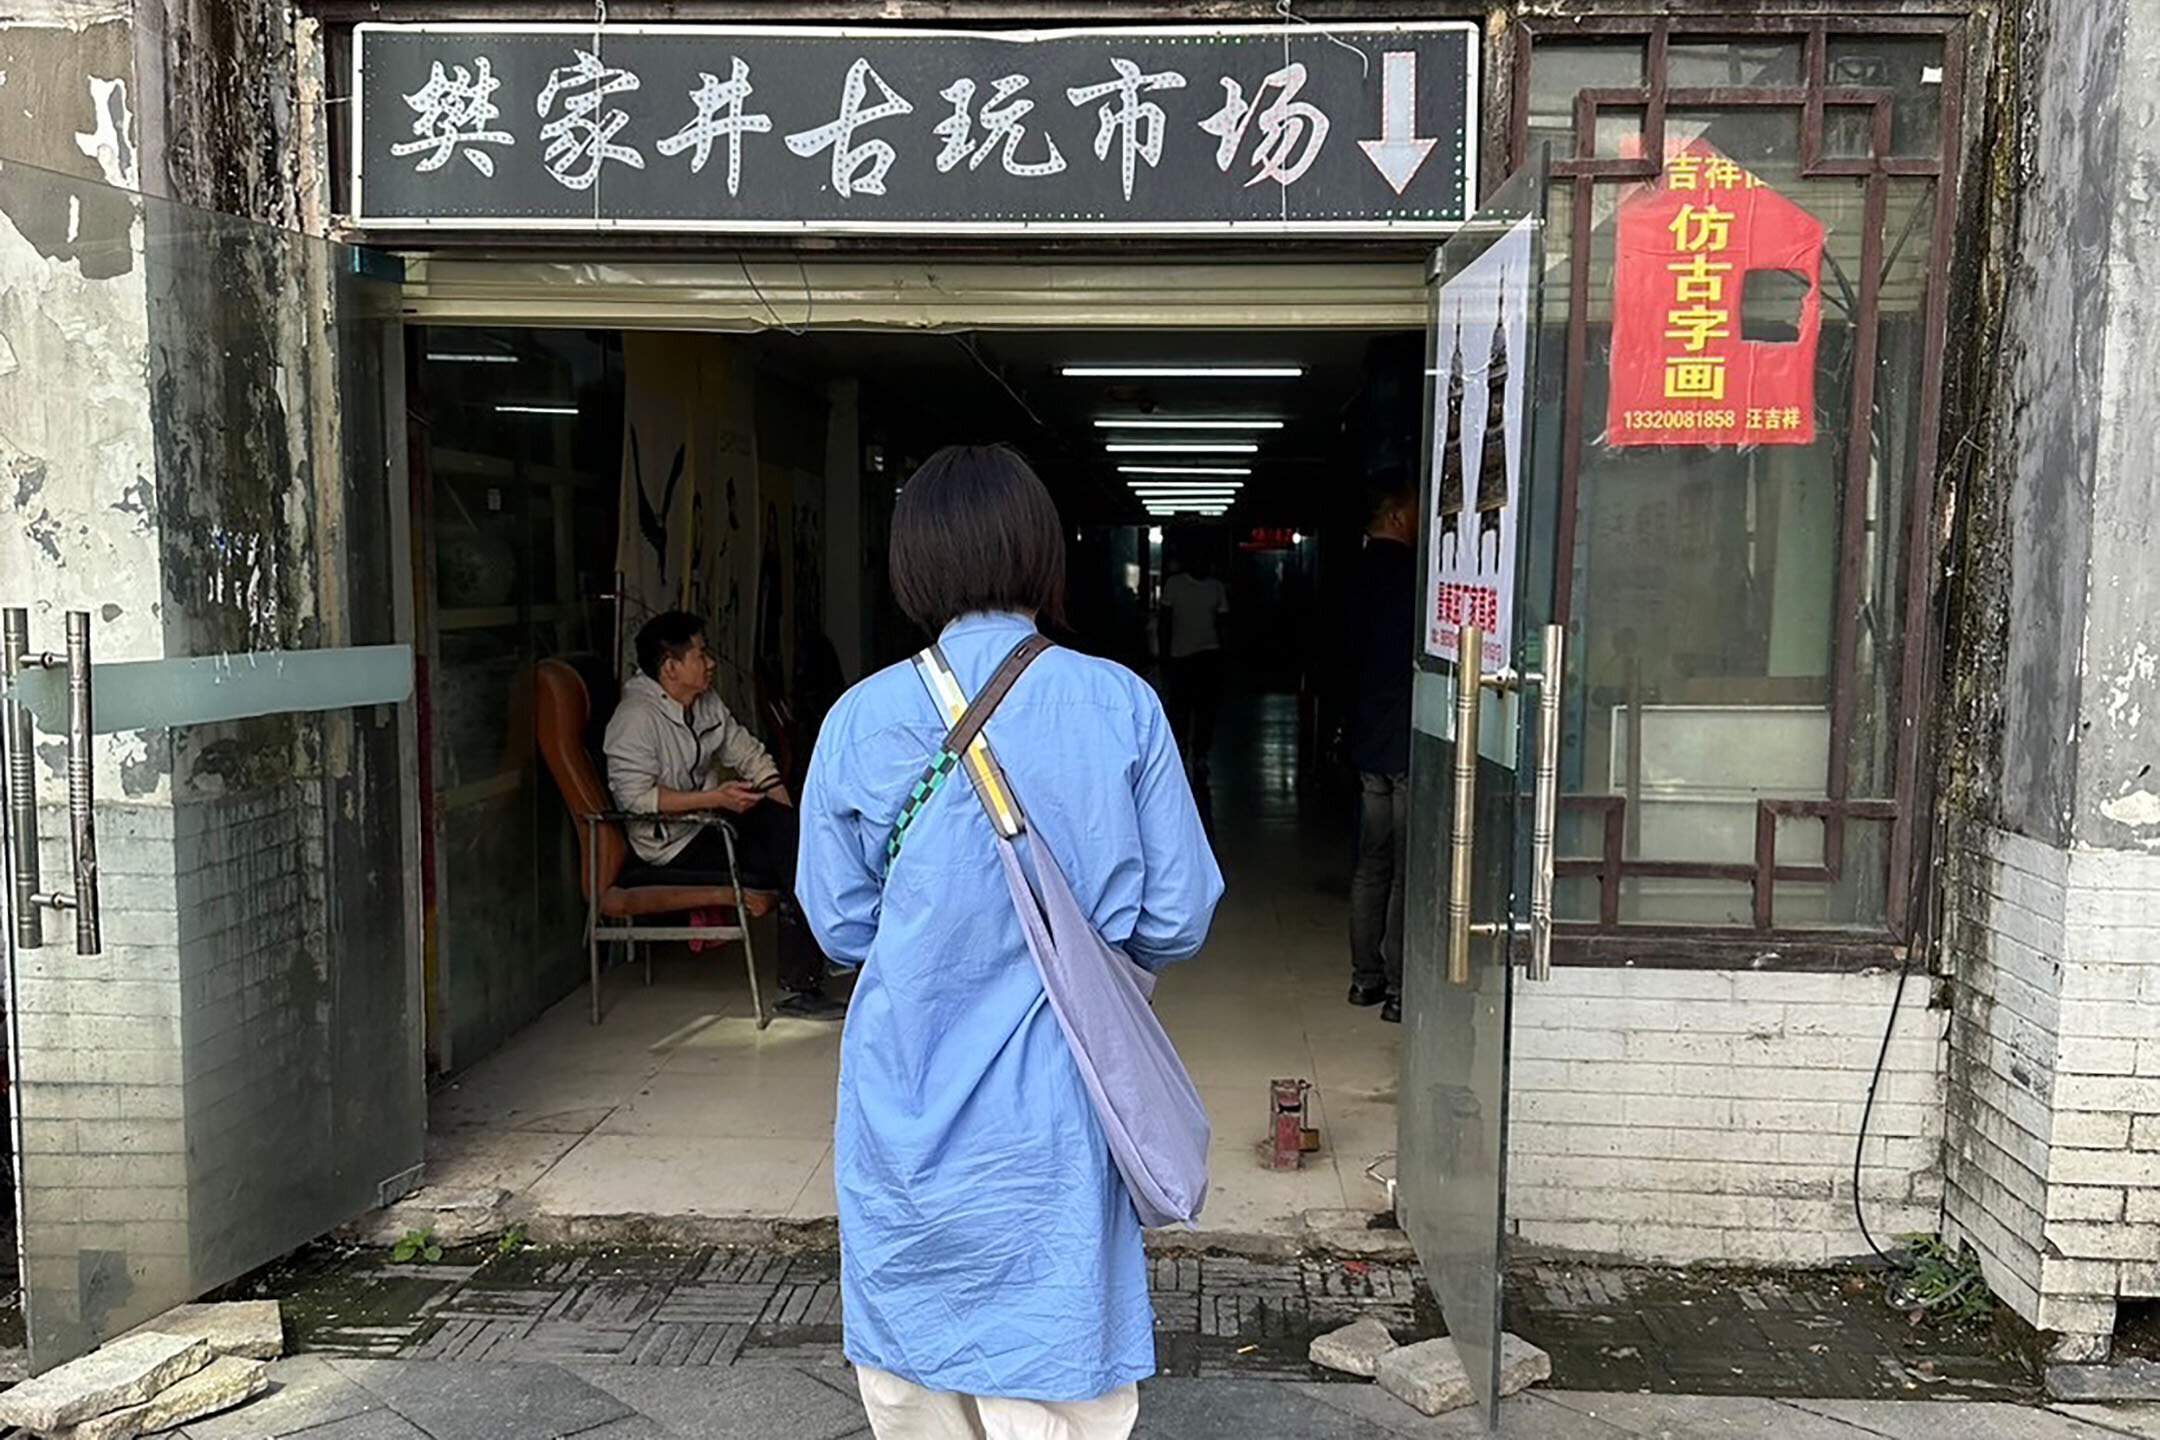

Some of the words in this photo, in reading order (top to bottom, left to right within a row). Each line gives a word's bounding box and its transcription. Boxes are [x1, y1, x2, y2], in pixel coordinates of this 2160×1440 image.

[390, 49, 1330, 201] 樊家井古玩市场
[1664, 203, 1735, 400] 仿古字画
[1624, 410, 1735, 430] 13320081858
[1746, 407, 1800, 430] 汪吉祥
